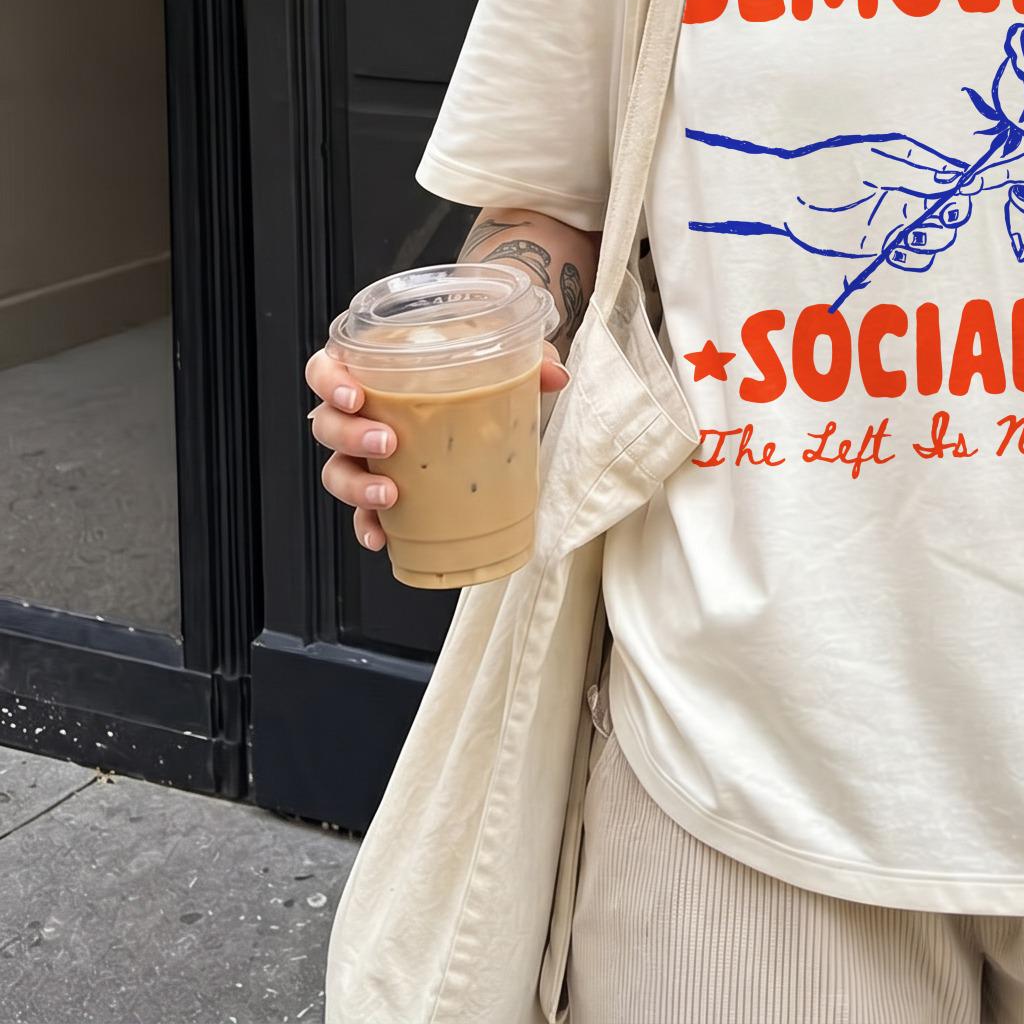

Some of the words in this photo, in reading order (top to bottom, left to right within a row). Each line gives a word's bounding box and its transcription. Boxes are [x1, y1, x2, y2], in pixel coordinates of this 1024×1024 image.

[691, 423, 785, 467] The
[802, 418, 895, 479] Left
[912, 410, 978, 458] Is
